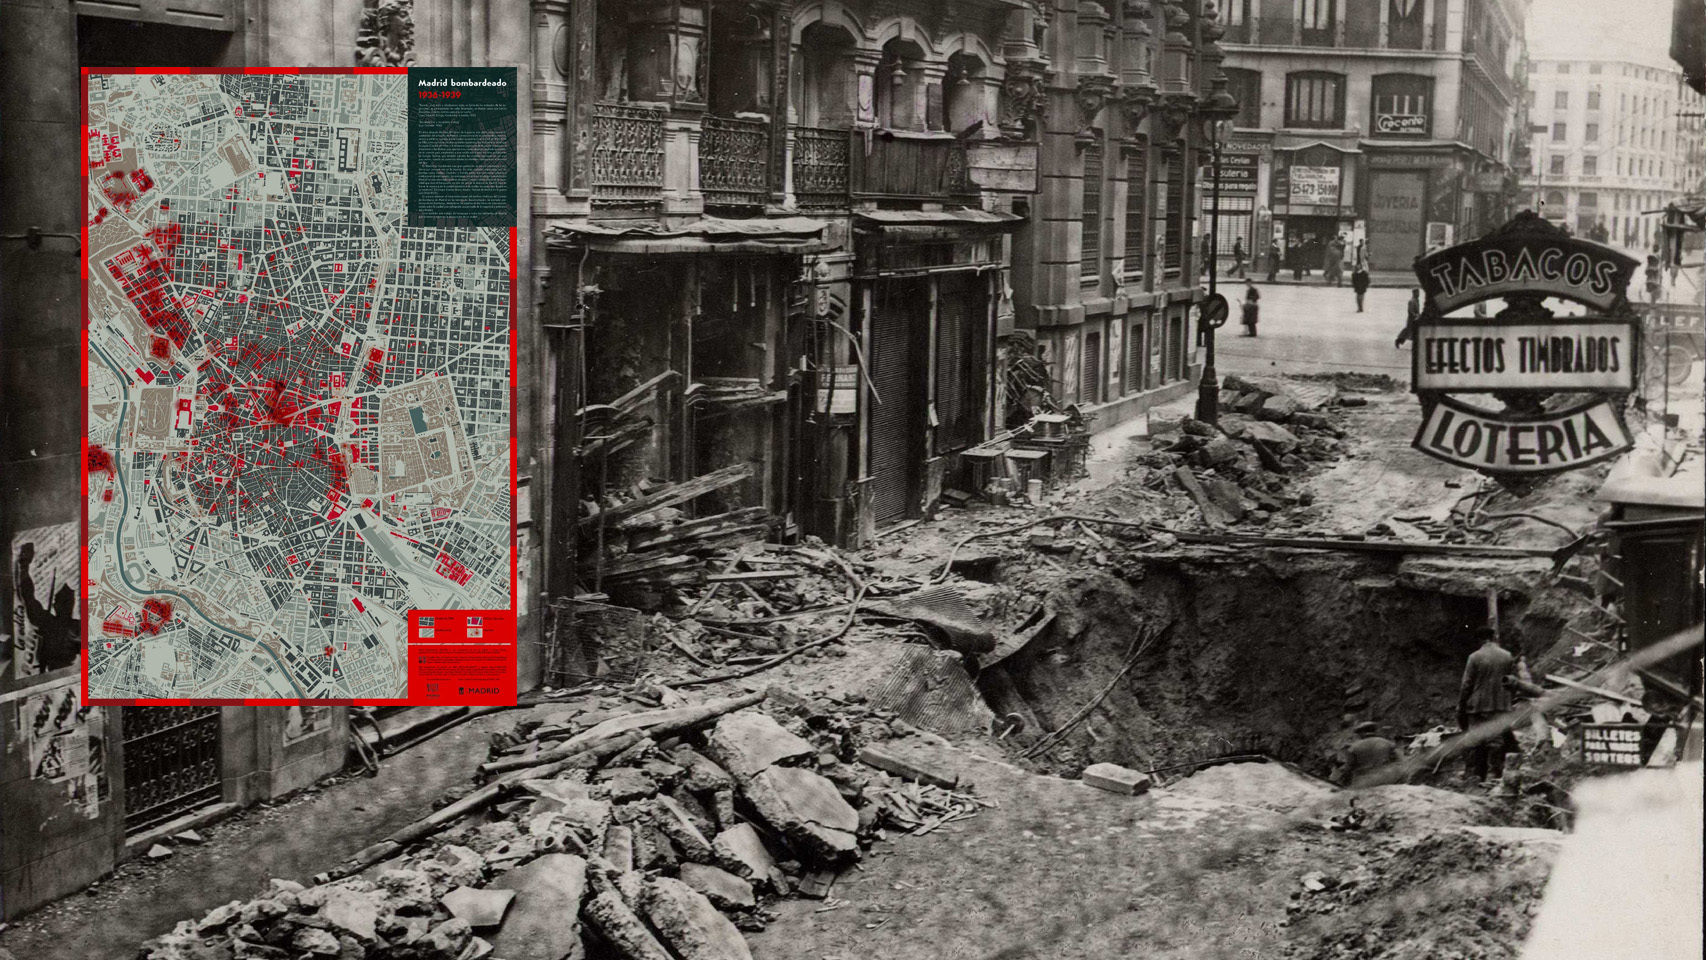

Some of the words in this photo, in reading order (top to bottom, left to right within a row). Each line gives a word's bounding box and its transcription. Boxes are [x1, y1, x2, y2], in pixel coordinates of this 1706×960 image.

[1431, 246, 1617, 299] TABACOS
[1425, 337, 1506, 374] EFECTOS
[1518, 335, 1620, 374] TIMBRADOS
[1430, 410, 1614, 465] LOTERIA
[1585, 729, 1641, 741] BILLETES
[1585, 752, 1641, 764] SORTEOS
